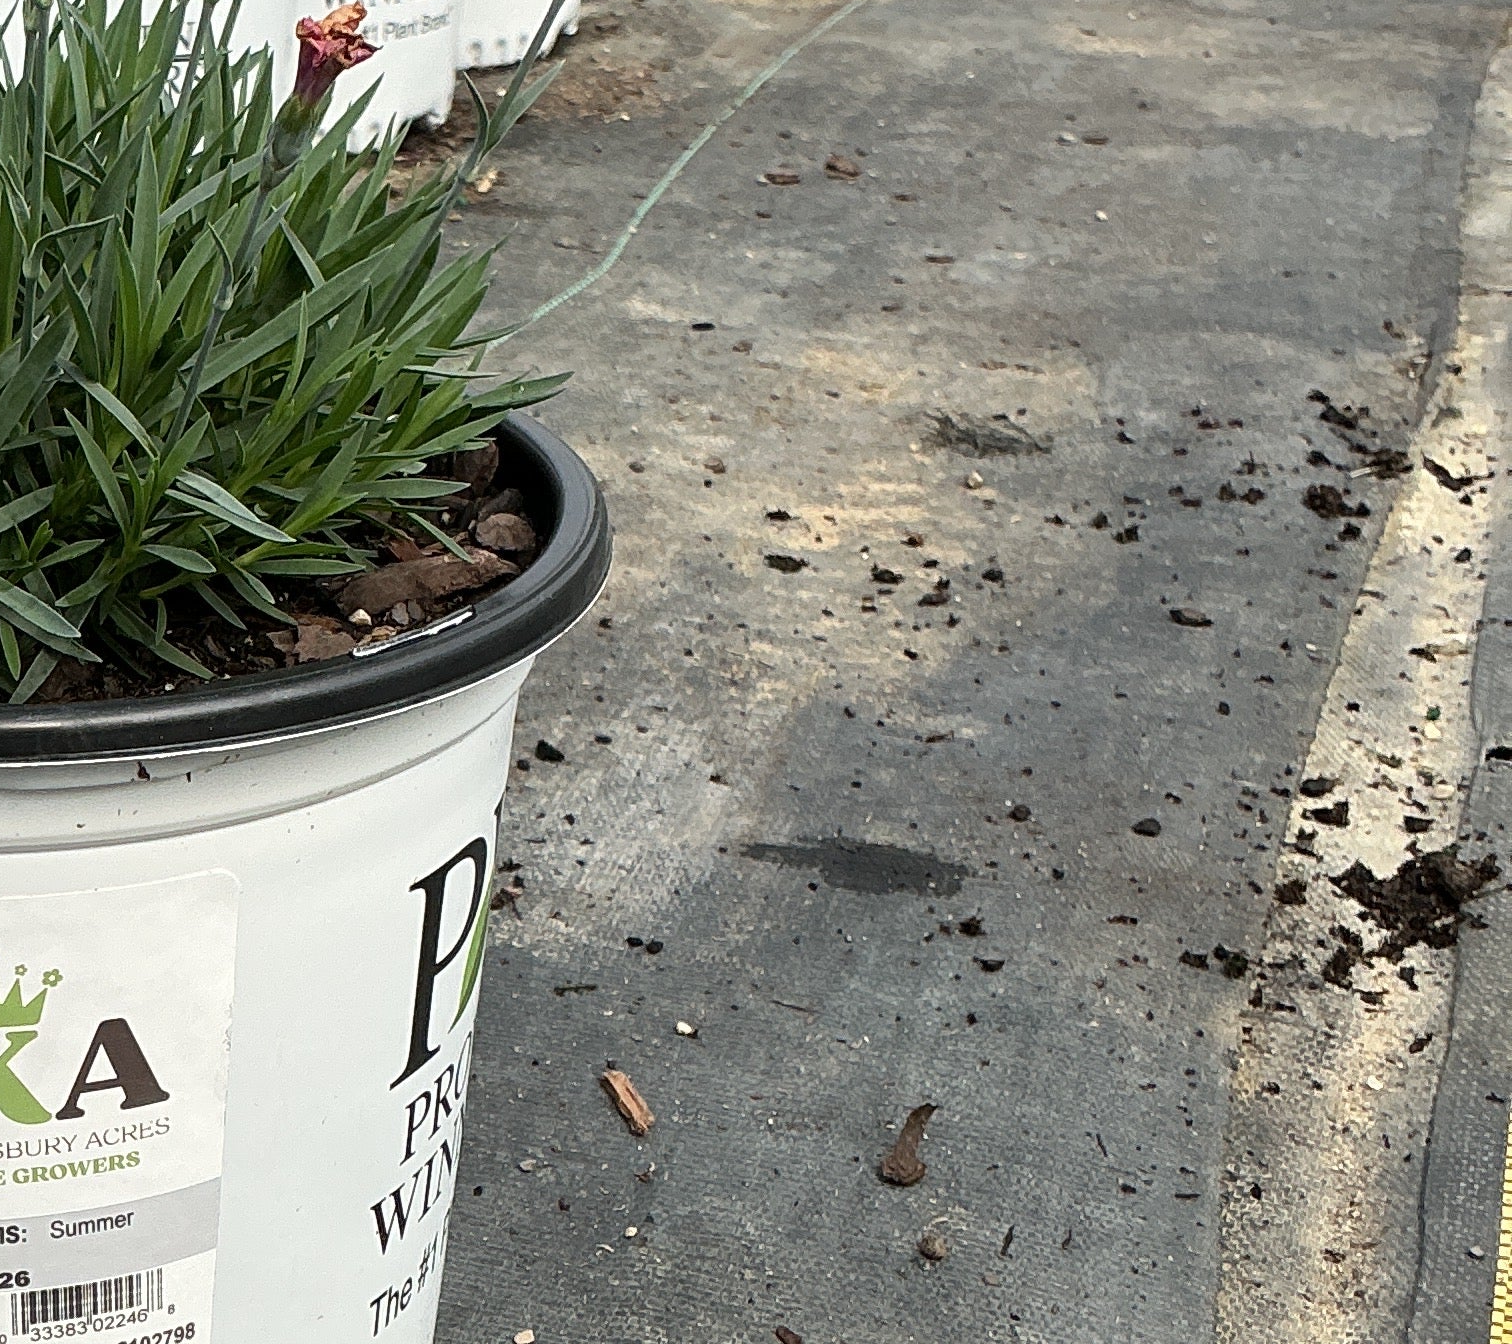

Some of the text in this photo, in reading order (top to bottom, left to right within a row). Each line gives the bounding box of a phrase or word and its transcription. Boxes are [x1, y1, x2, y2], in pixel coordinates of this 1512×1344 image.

[84, 1116, 172, 1150] ACRES
[12, 1150, 142, 1185] GROWERS
[49, 1210, 136, 1240] Summer
[369, 1276, 413, 1338] The
[29, 1320, 89, 1343] 33383
[92, 1307, 149, 1333] 02246
